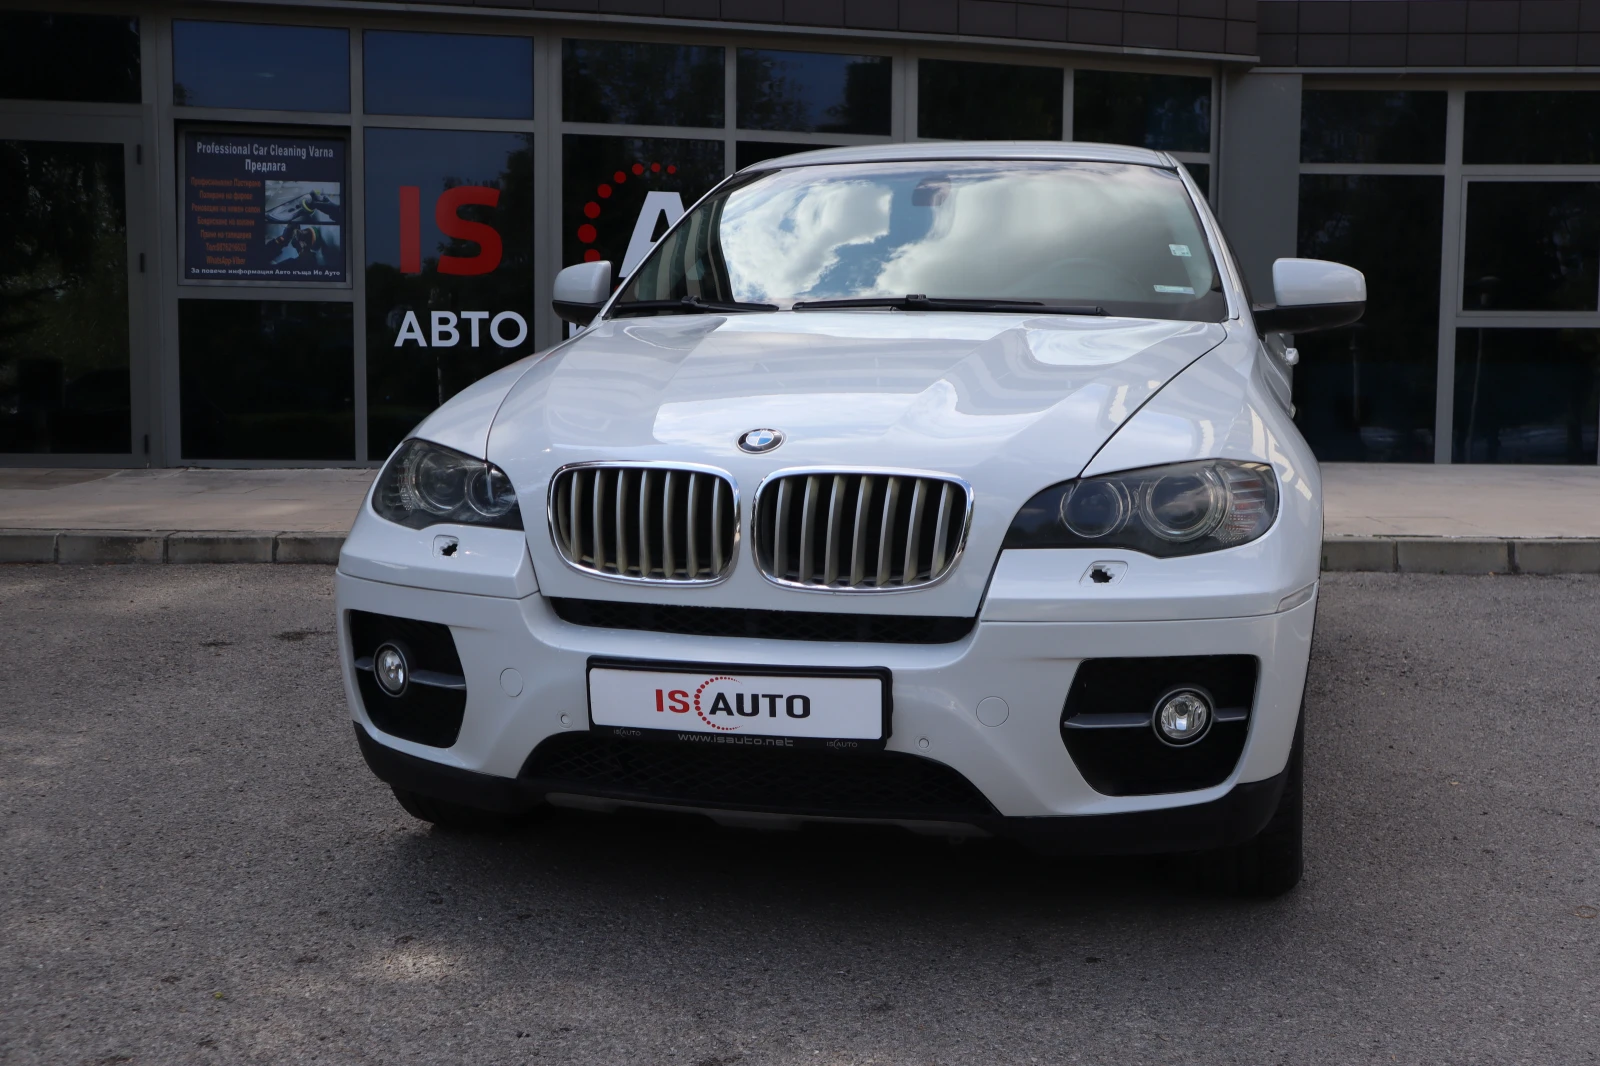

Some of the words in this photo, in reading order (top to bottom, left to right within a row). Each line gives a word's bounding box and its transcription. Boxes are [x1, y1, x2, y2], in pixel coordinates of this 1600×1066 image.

[197, 142, 250, 155] Professional
[253, 144, 267, 155] Car
[270, 144, 307, 159] Cleaning
[309, 146, 334, 158] Varna
[245, 159, 286, 173] Предлага
[399, 185, 503, 276] IS
[394, 311, 528, 348] АВТО
[655, 689, 690, 713] IS
[709, 692, 811, 719] AUTO
[677, 732, 794, 747] www.isauto.net
